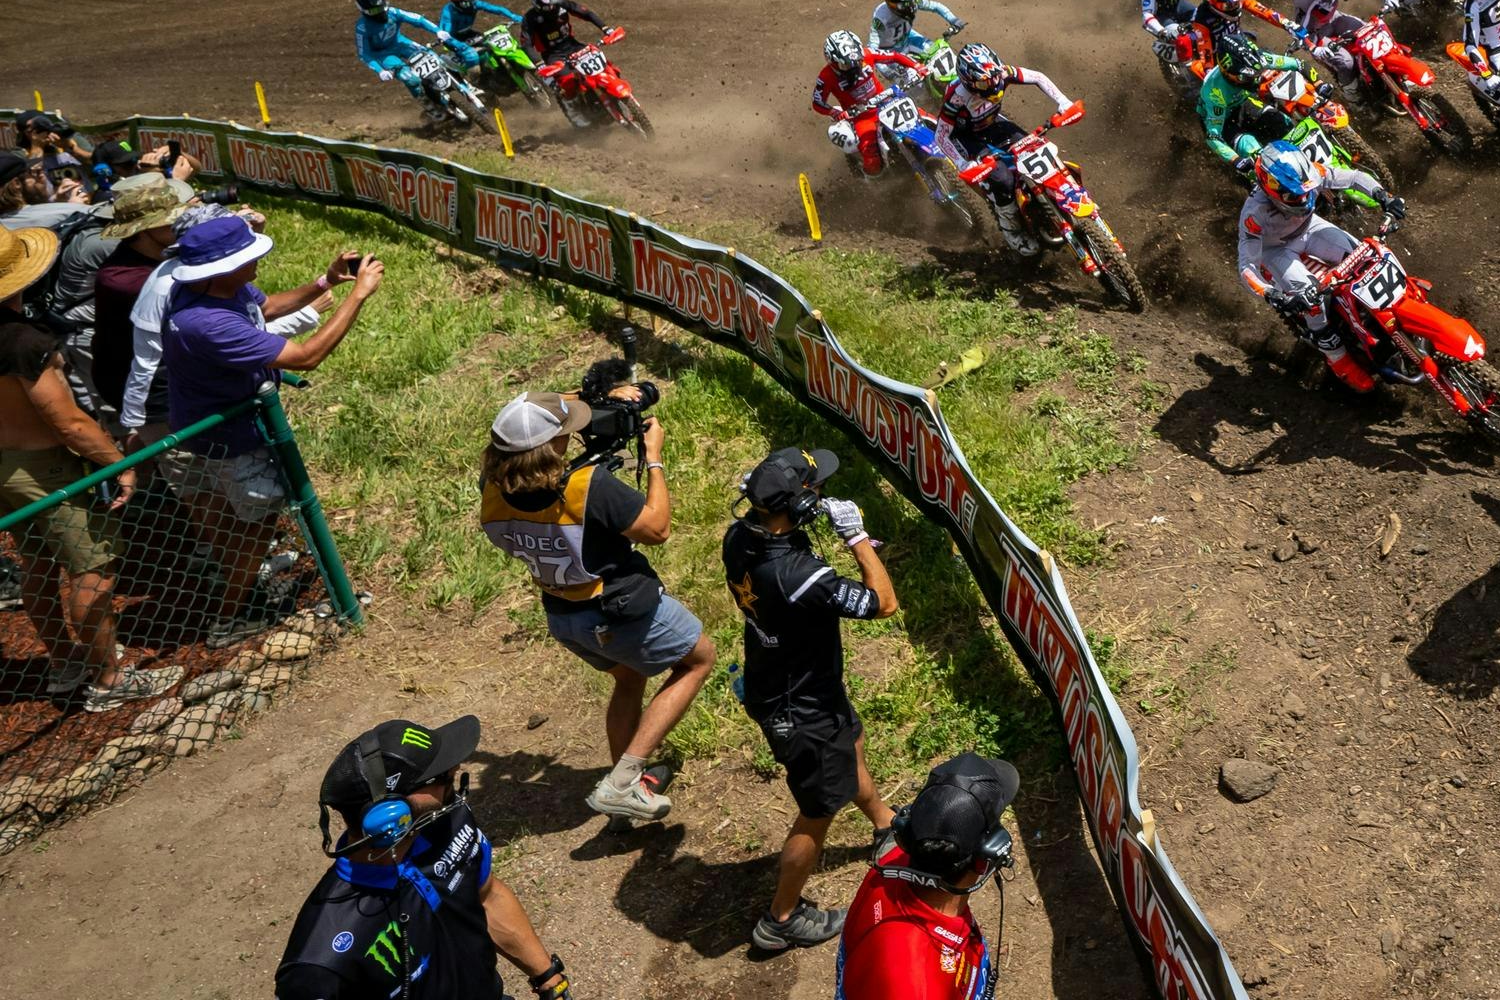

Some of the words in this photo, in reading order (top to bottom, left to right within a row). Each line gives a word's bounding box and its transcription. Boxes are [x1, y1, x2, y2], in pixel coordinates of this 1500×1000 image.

[1366, 30, 1394, 60] 23
[416, 58, 438, 77] 275
[933, 50, 954, 76] 17
[1277, 70, 1298, 100] 7
[886, 100, 915, 129] 26
[1022, 146, 1059, 177] 51
[1303, 134, 1332, 161] 21
[228, 134, 338, 196] MOTOSPORT
[346, 154, 457, 234] MOTOSPORT
[475, 185, 615, 284] MOTOSPORT
[1368, 262, 1407, 308] 94
[441, 824, 474, 865] YAMAHA
[883, 869, 938, 889] SENA
[934, 926, 963, 944] GASGAS
